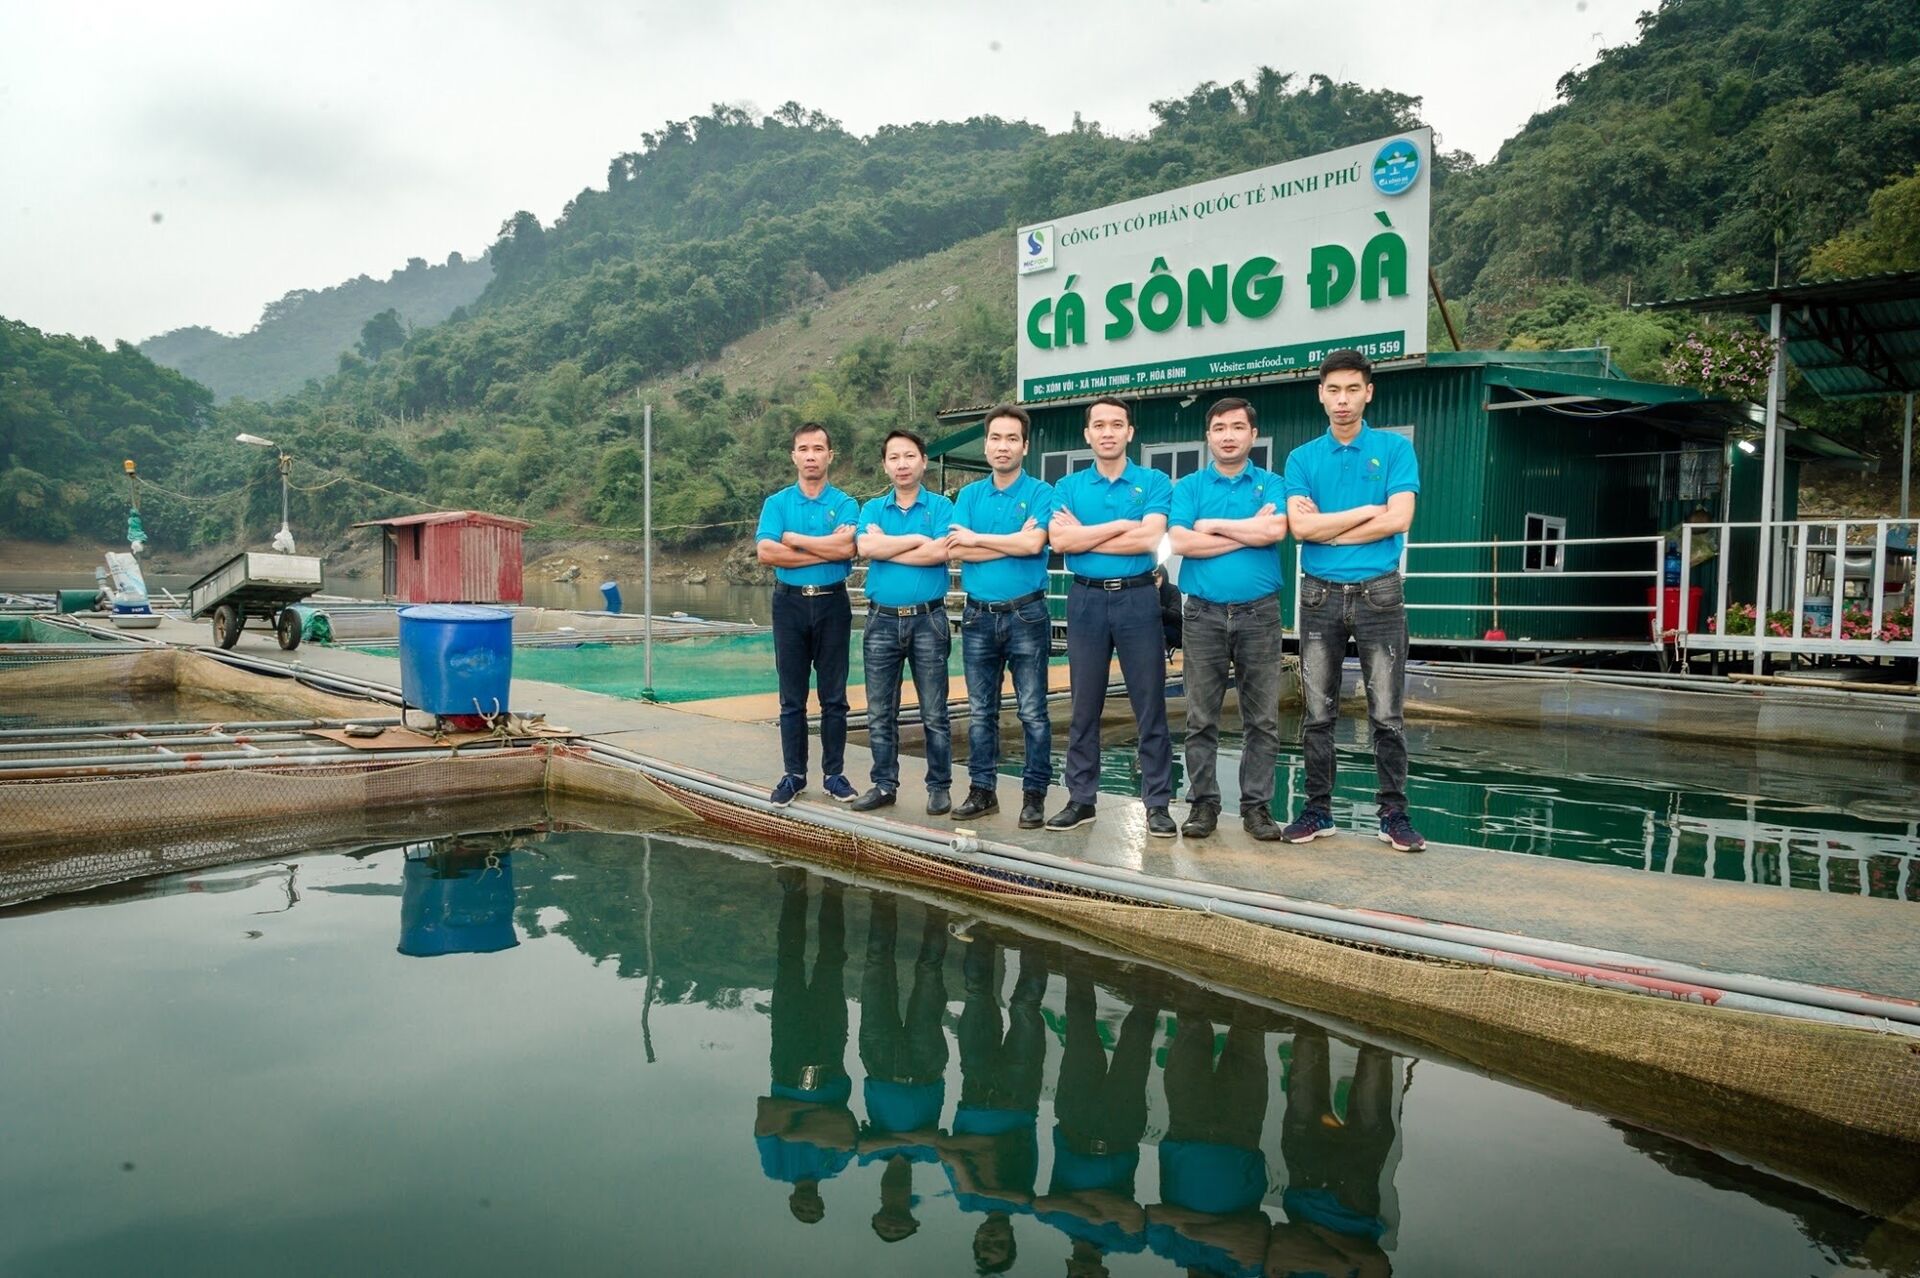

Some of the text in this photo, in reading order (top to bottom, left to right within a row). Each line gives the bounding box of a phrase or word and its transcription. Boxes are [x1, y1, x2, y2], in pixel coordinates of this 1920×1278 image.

[1061, 228, 1099, 247] CÔNG
[1102, 220, 1121, 237] TY
[1193, 192, 1241, 219] QUỐC
[1244, 183, 1267, 206] TẾ
[1271, 175, 1318, 201] MINH
[1324, 161, 1362, 188] PHÚ
[1026, 211, 1408, 350] CÁ SÔNG ĐÀ
[1379, 340, 1400, 354] 559
[1209, 355, 1295, 373] Website: micfood.vn
[1136, 372, 1148, 383] TP.
